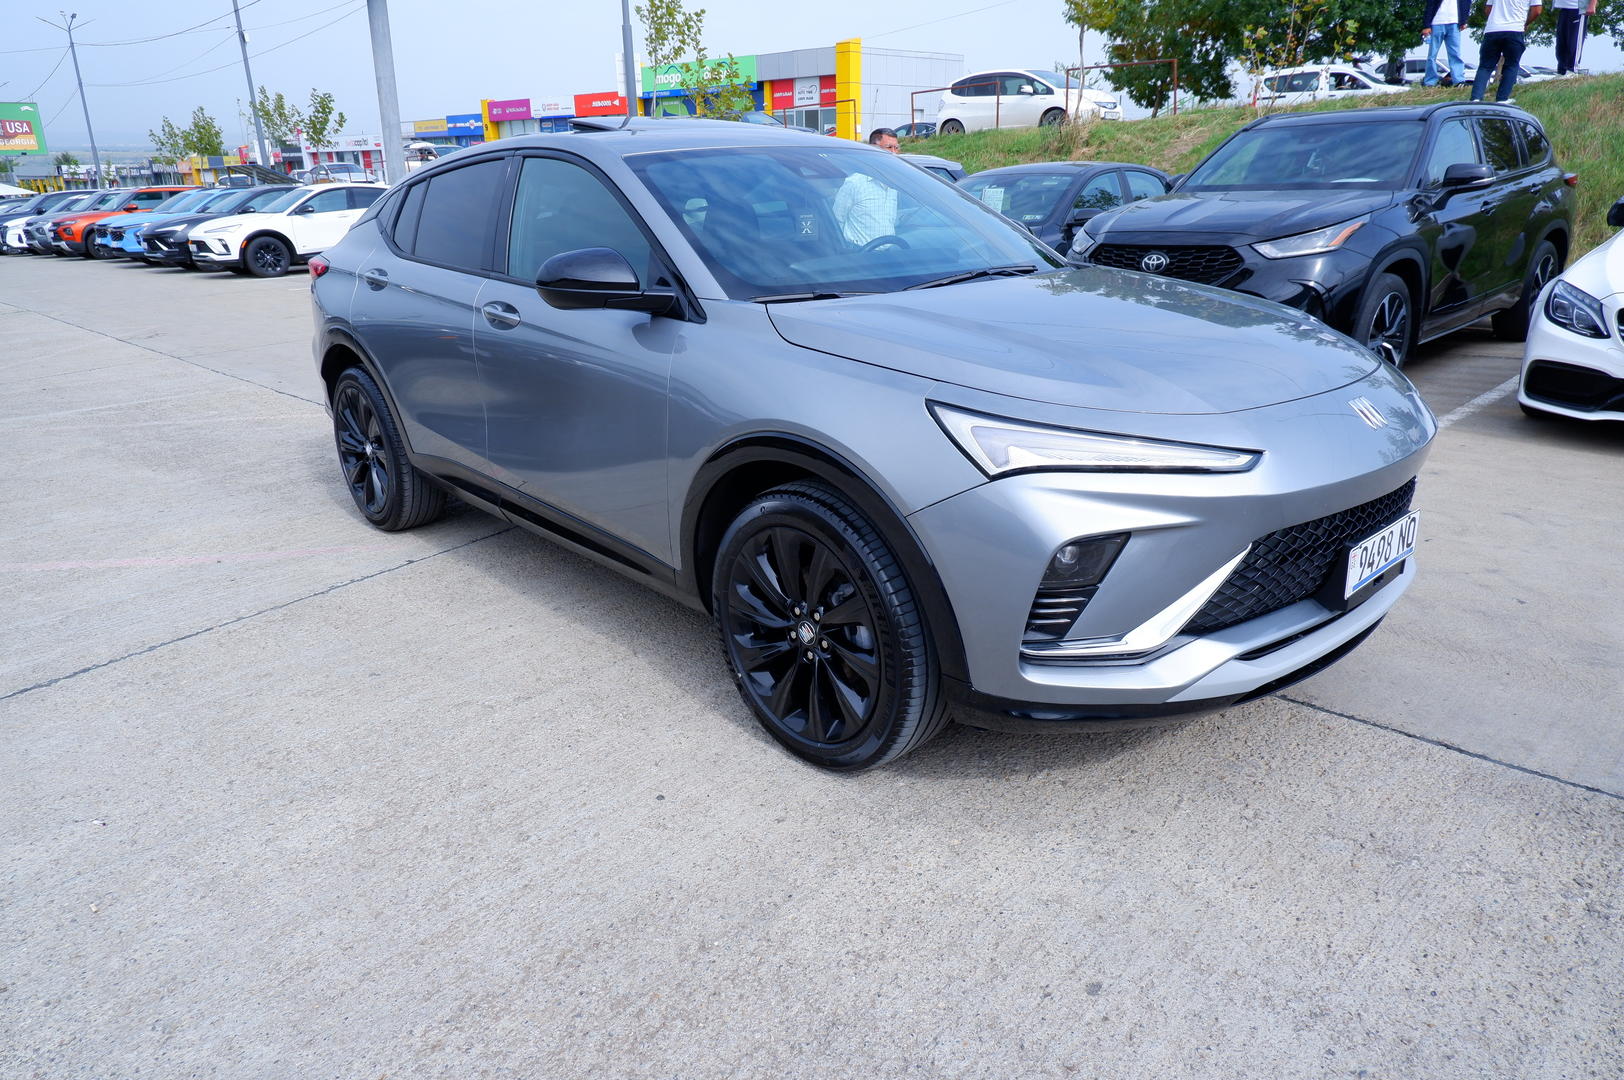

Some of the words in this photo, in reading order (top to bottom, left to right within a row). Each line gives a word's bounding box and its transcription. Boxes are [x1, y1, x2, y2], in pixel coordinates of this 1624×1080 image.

[656, 73, 682, 88] mogo
[6, 122, 30, 133] USA
[1358, 530, 1394, 581] 9498
[1396, 516, 1417, 556] NO
